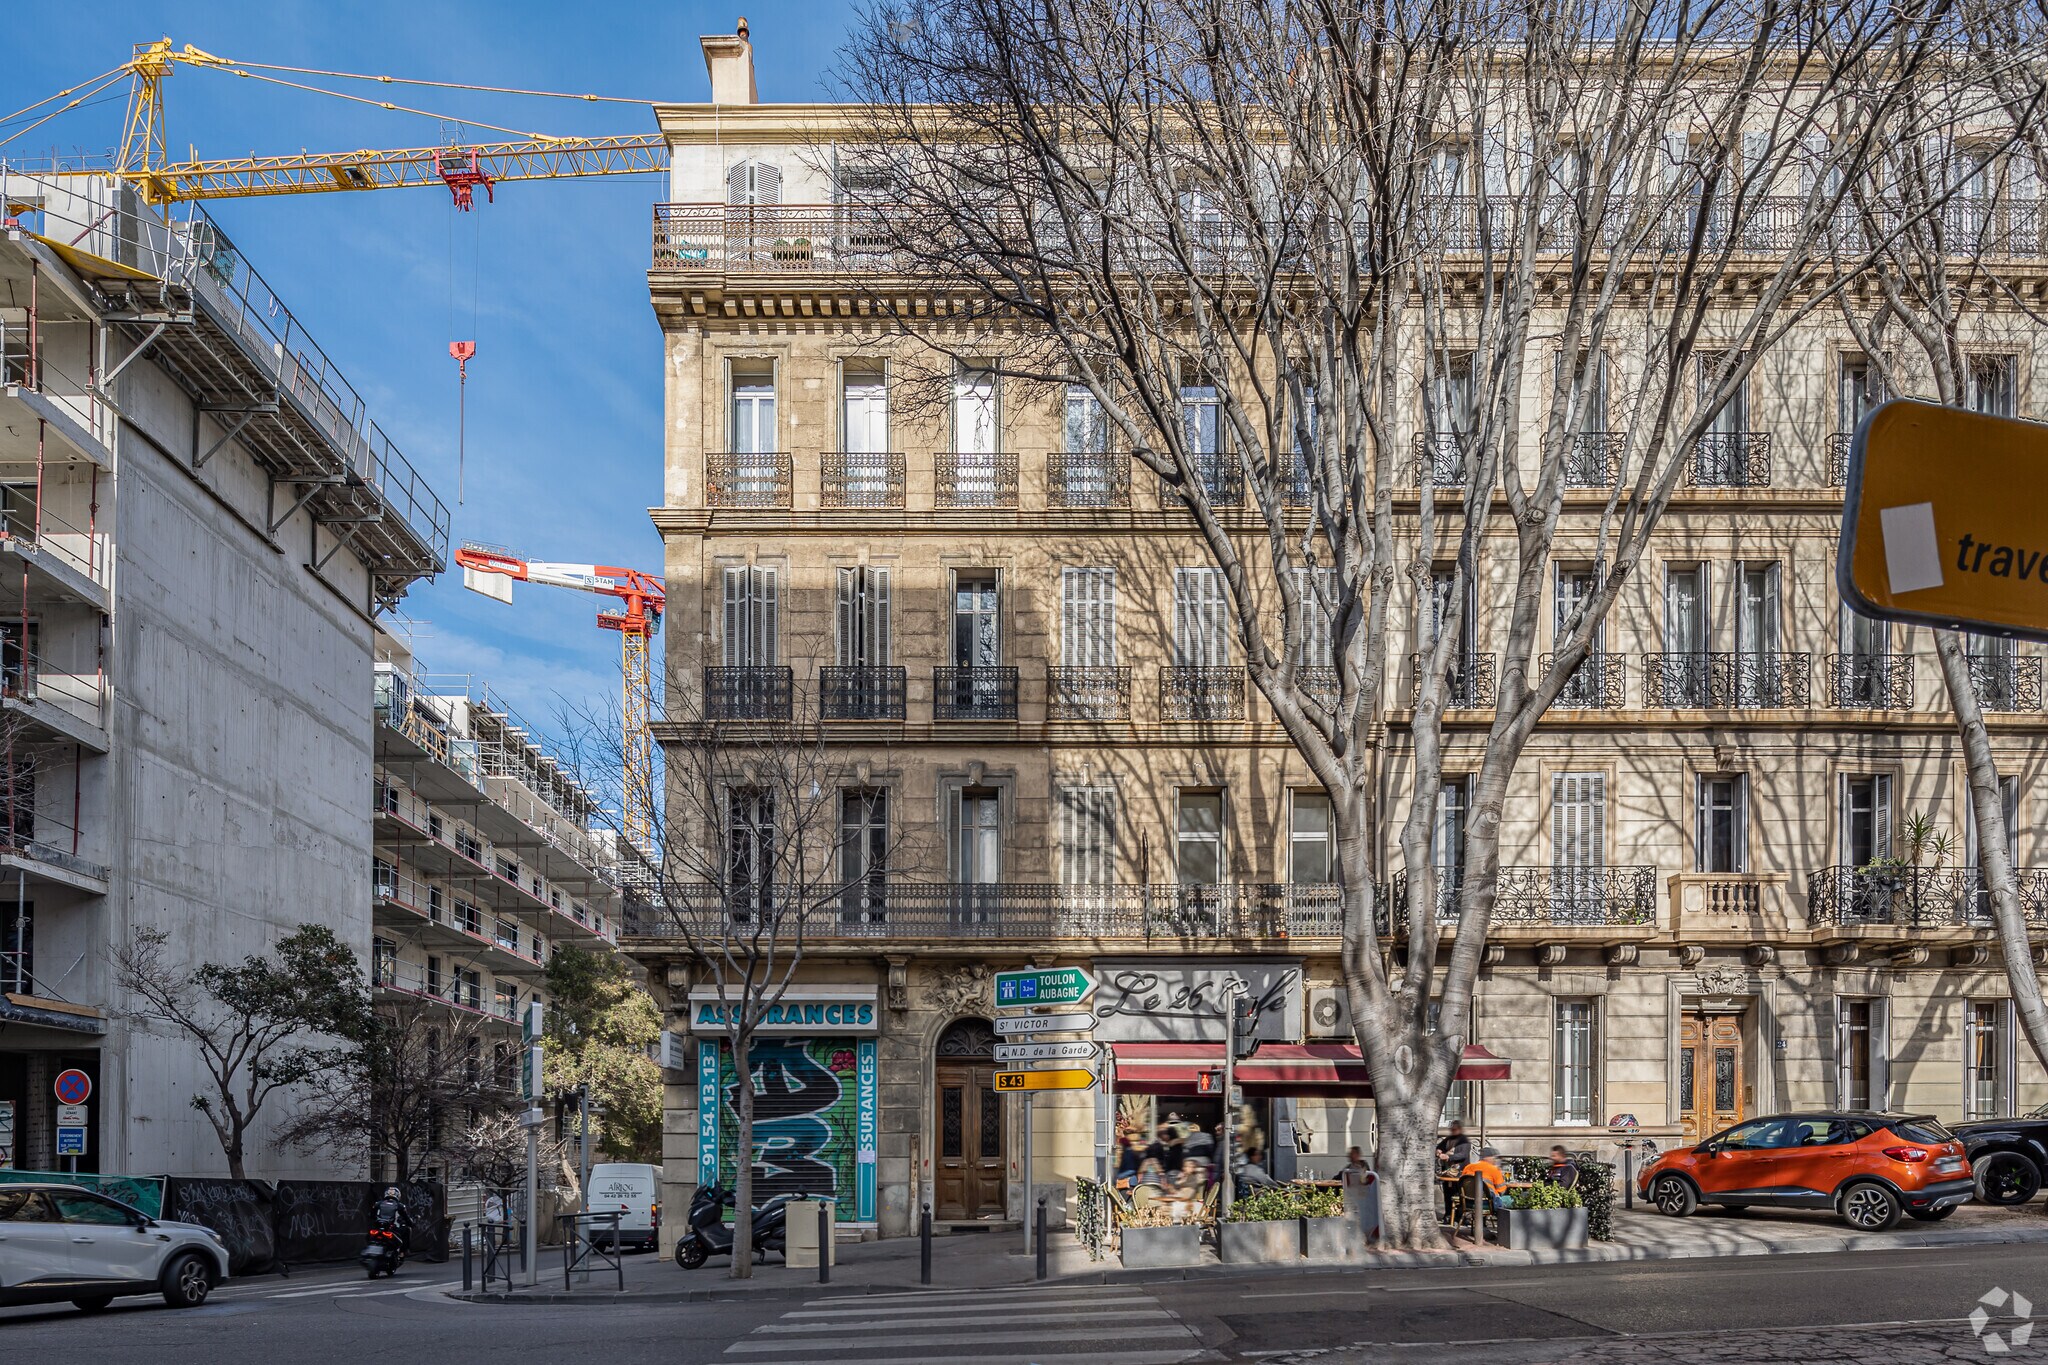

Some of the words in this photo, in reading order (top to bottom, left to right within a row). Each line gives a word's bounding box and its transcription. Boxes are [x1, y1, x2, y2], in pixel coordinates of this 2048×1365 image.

[595, 577, 613, 585] STAM
[1040, 974, 1075, 985] TOULON
[1040, 986, 1080, 999] AUBAGNE
[1097, 971, 1162, 1018] Le
[1167, 981, 1214, 1011] 26
[1014, 1019, 1049, 1029] VICTOR
[1777, 1040, 1786, 1048] 24
[1011, 1047, 1028, 1056] N.D.
[1033, 1047, 1044, 1056] de
[1048, 1046, 1057, 1055] la
[1061, 1045, 1088, 1055] Garde
[1000, 1076, 1007, 1086] S
[1009, 1075, 1023, 1086] 43
[861, 1054, 874, 1152] SSURANCES
[702, 1055, 716, 1166] 91.54.13.13
